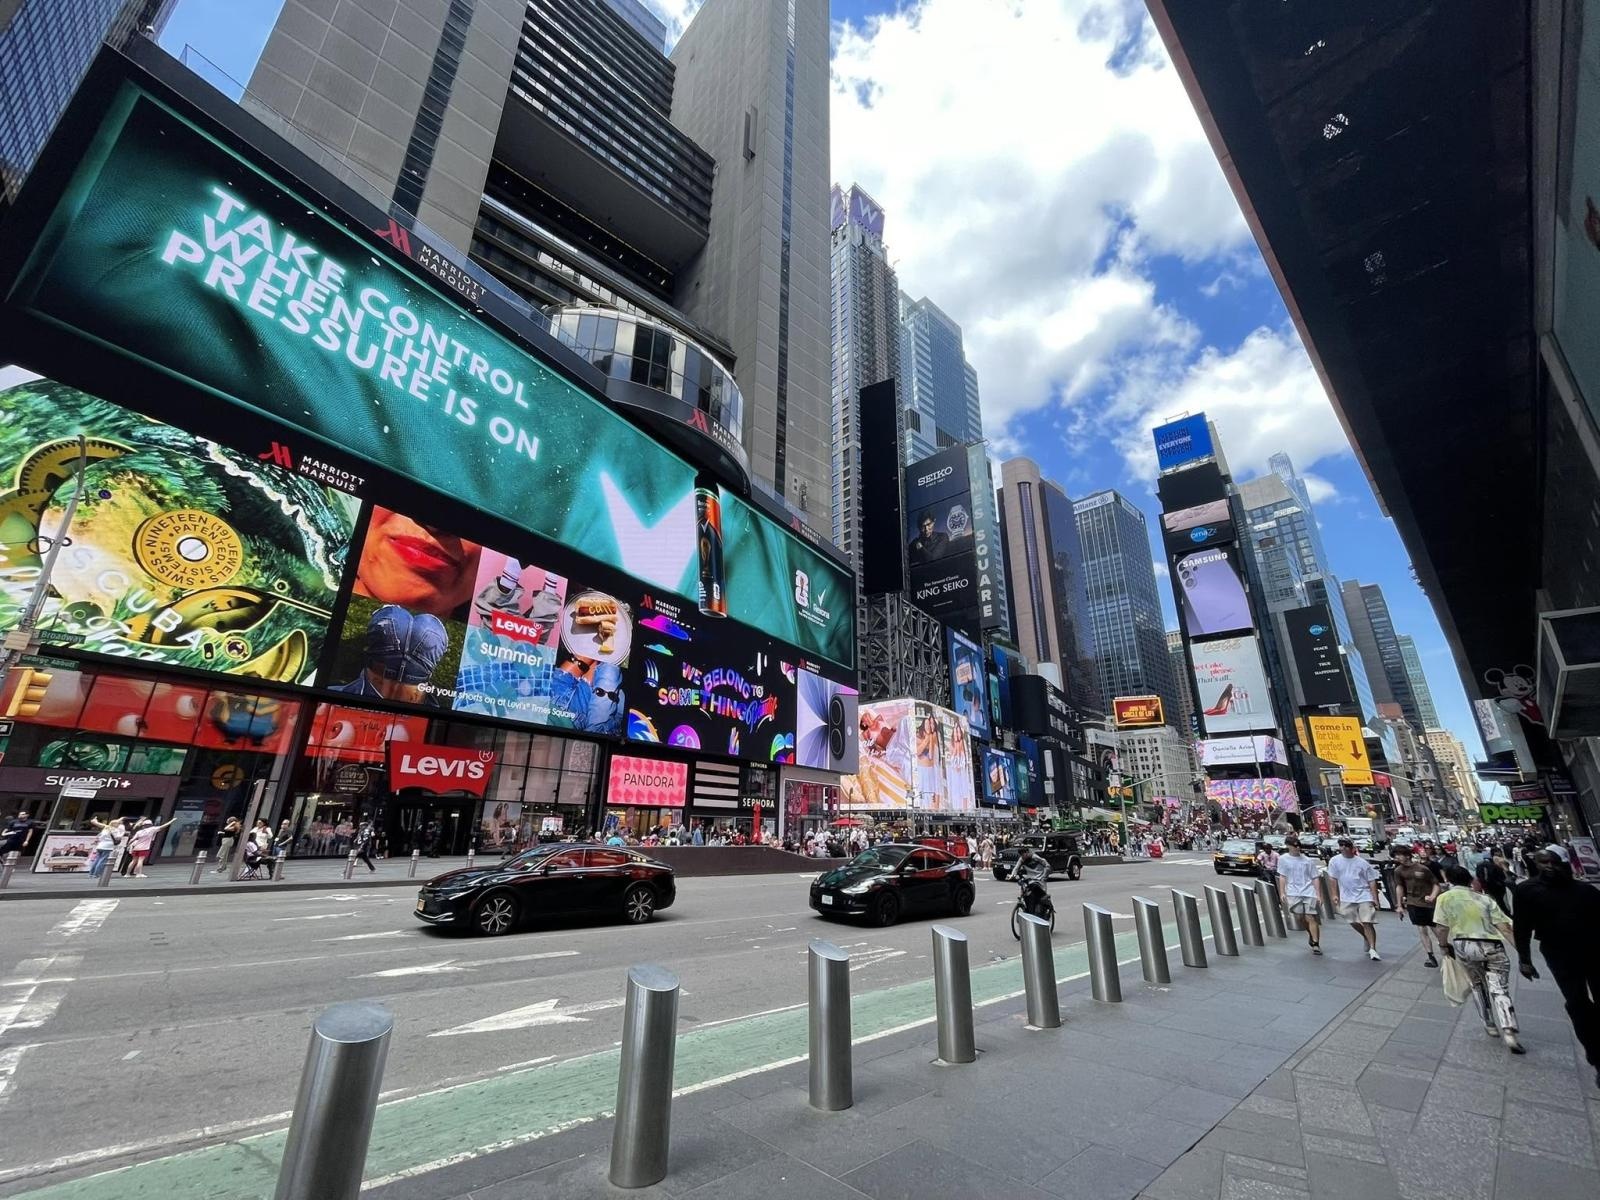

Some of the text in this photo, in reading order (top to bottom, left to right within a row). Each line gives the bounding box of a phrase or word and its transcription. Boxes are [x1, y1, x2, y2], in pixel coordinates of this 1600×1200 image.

[859, 195, 878, 224] W
[419, 254, 477, 300] MARQUIS
[422, 245, 487, 295] MARRIOTT
[203, 214, 452, 385] WHEN THE
[213, 187, 529, 409] TAKE CONTROL
[161, 230, 540, 461] PRESSURE IS ON
[1159, 435, 1192, 451] EVERYONE
[300, 465, 355, 491] MARQUIS
[303, 455, 365, 486] MARRIOTT
[917, 466, 953, 486] SEIKO
[145, 513, 238, 583] NINETEEN (19) JEWELS
[172, 523, 227, 562] PATENTED
[969, 454, 992, 618] TIMES SQUARE
[150, 558, 195, 586] SWISS
[160, 541, 214, 576] SISTEM51
[1182, 552, 1228, 567] SAMSUNG
[71, 546, 203, 651] SCUBA
[917, 586, 940, 599] KING
[943, 578, 969, 592] SEIKO
[655, 606, 677, 618] MARQUIS
[656, 600, 680, 613] MARRIOTT
[41, 631, 84, 643] Broadway
[480, 642, 543, 667] summer
[682, 661, 763, 699] WE BELONG TO
[417, 682, 436, 694] Get
[436, 687, 457, 698] your
[458, 691, 482, 703] shorts
[484, 696, 496, 704] on
[498, 698, 506, 706] at
[531, 704, 550, 715] Times
[551, 708, 576, 720] Square
[658, 686, 747, 721] SOMETHING
[1327, 731, 1340, 740] the
[1342, 723, 1352, 731] in
[623, 773, 674, 788] PANDORA
[742, 797, 775, 808] SEPHORA
